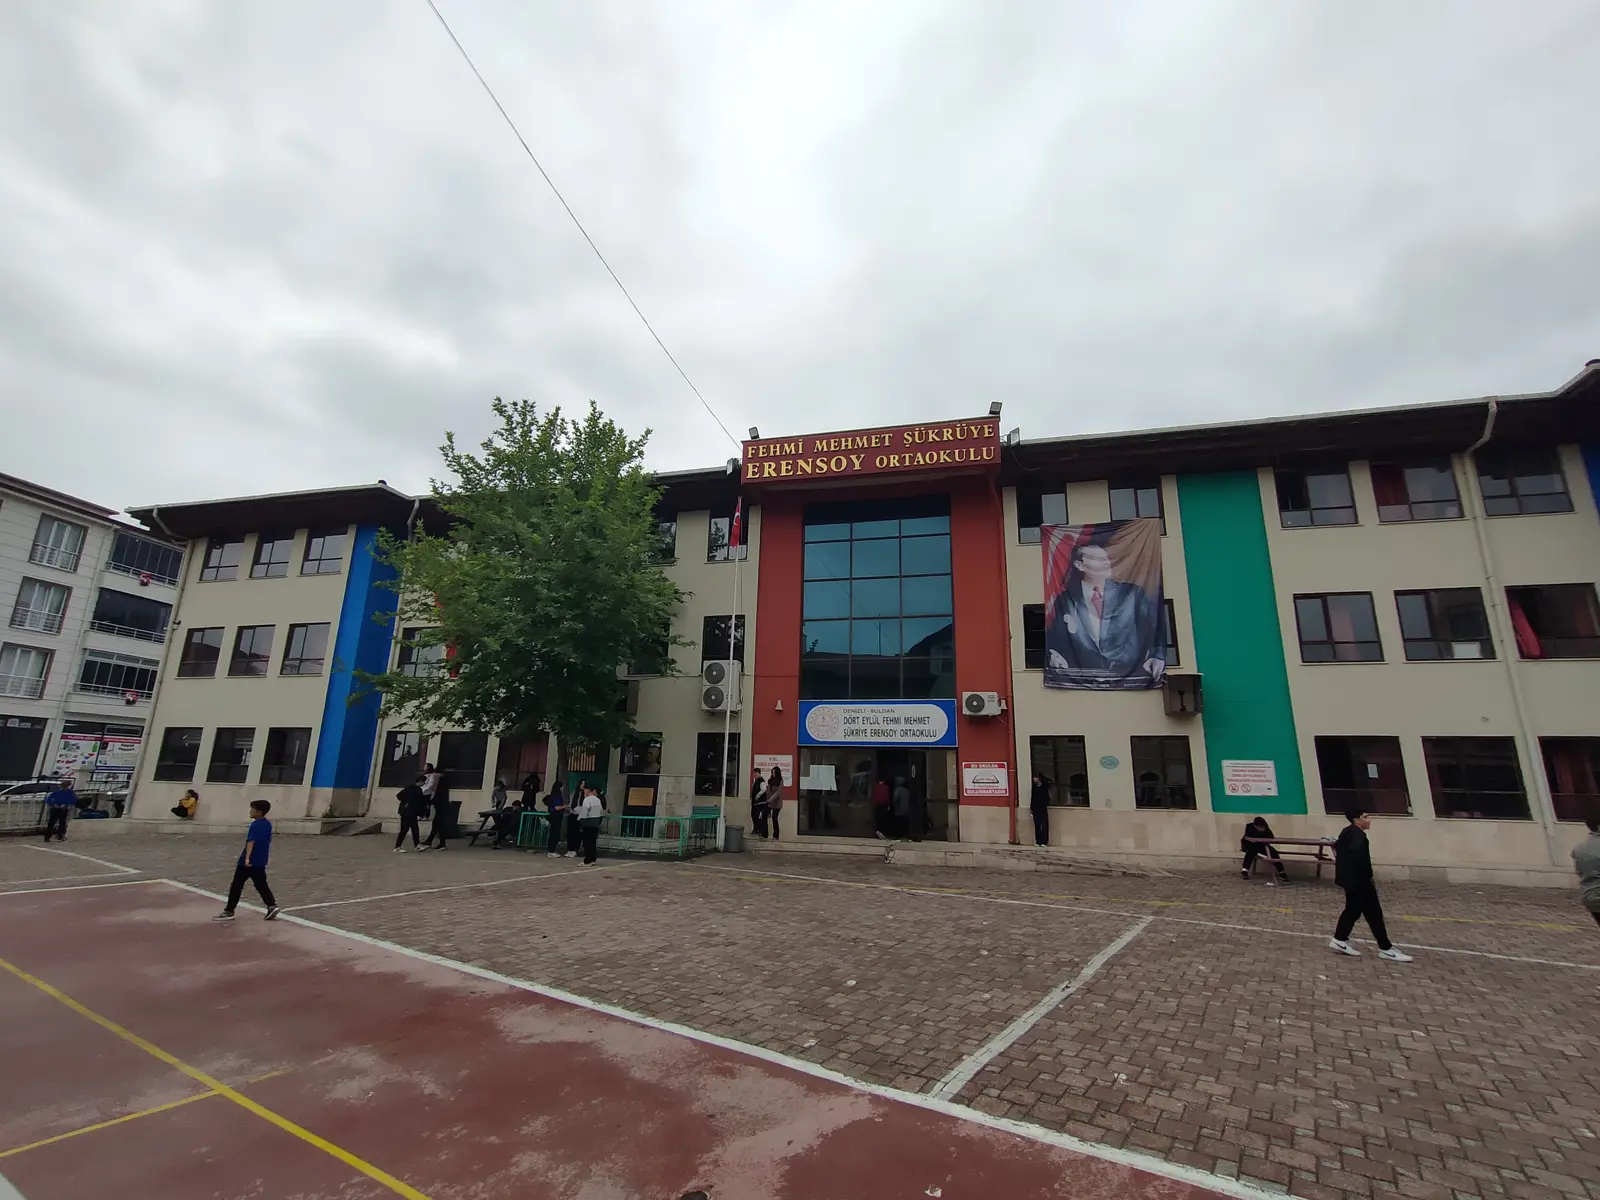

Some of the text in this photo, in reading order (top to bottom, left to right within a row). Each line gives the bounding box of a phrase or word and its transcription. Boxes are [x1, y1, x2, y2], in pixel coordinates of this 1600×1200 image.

[747, 423, 995, 459] FEHMİ MEHMET ŞÜKRÜYE
[745, 446, 996, 479] ERENSOY ORTAOKULU
[843, 715, 931, 725] DÖRT EYLÜL FEHMİ MEHMET
[843, 727, 937, 739] ŞÜKRİYE ERENSOY ORTAOKULU
